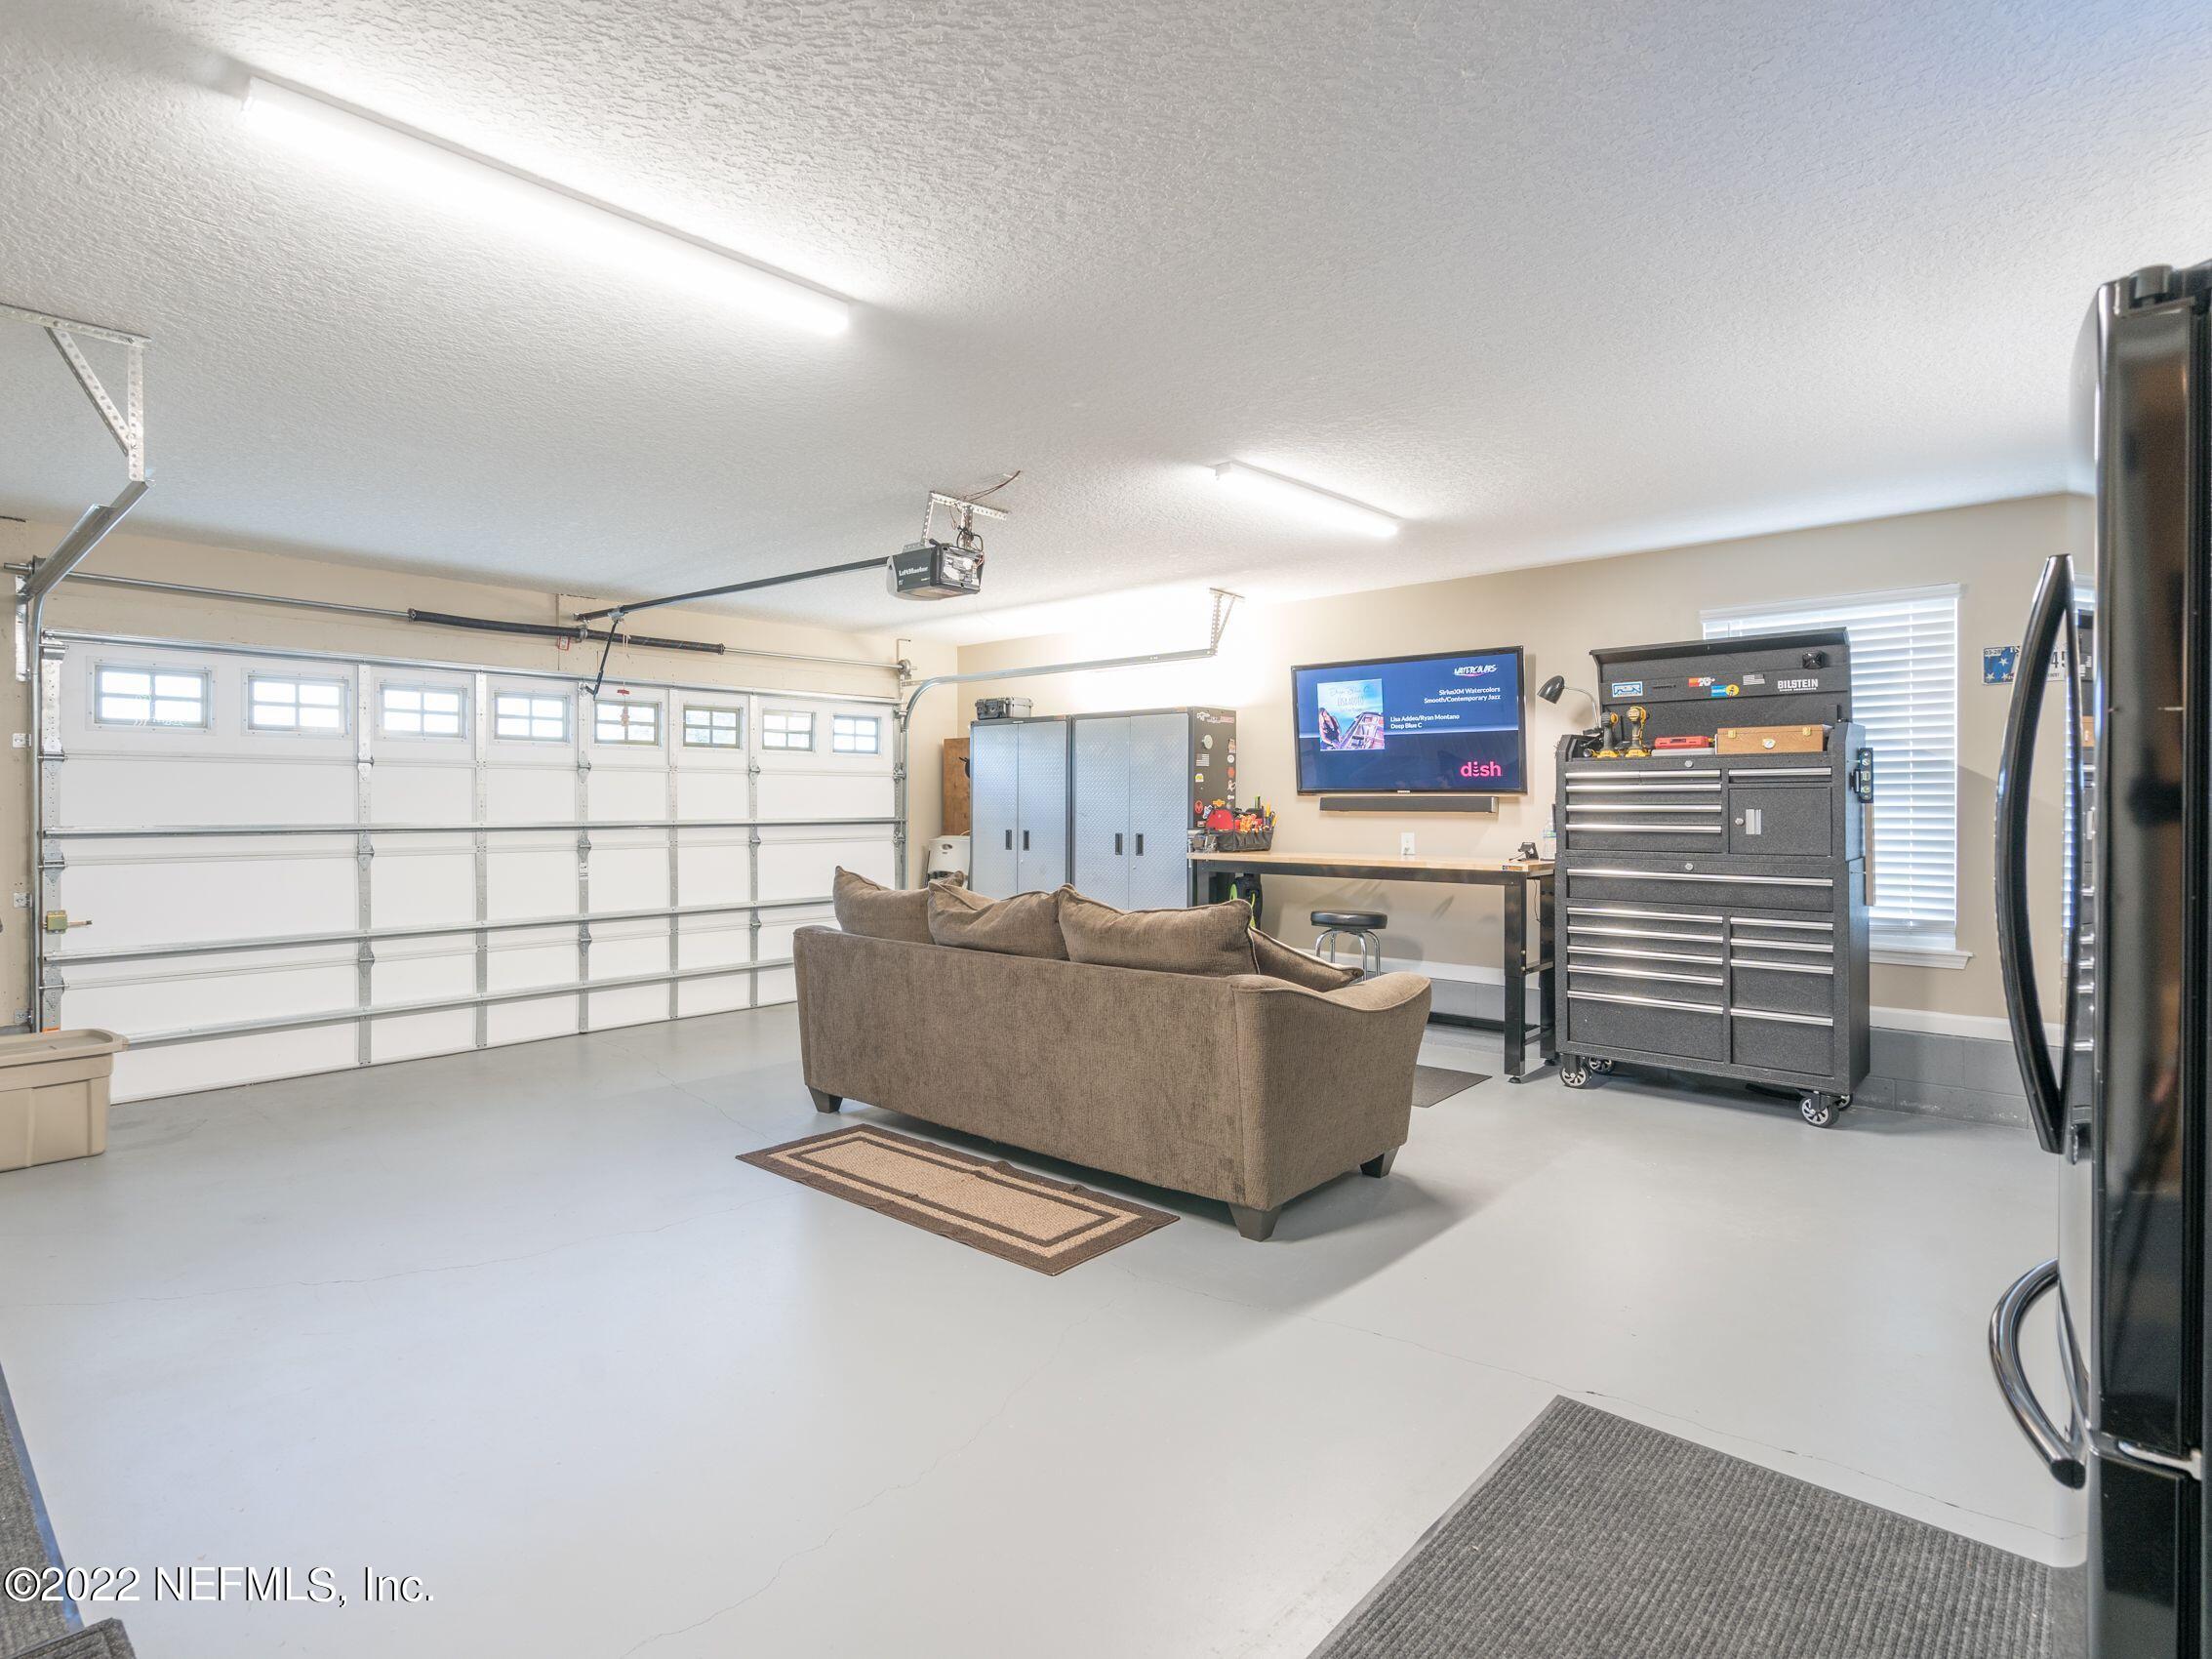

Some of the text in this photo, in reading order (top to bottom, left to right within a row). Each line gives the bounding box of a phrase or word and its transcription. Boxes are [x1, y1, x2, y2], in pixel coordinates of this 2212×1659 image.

[1777, 678, 1819, 689] BILSTEIN
[1466, 686, 1501, 695] Watercolors
[1390, 722, 1404, 731] Deep
[1460, 760, 1502, 777] dish
